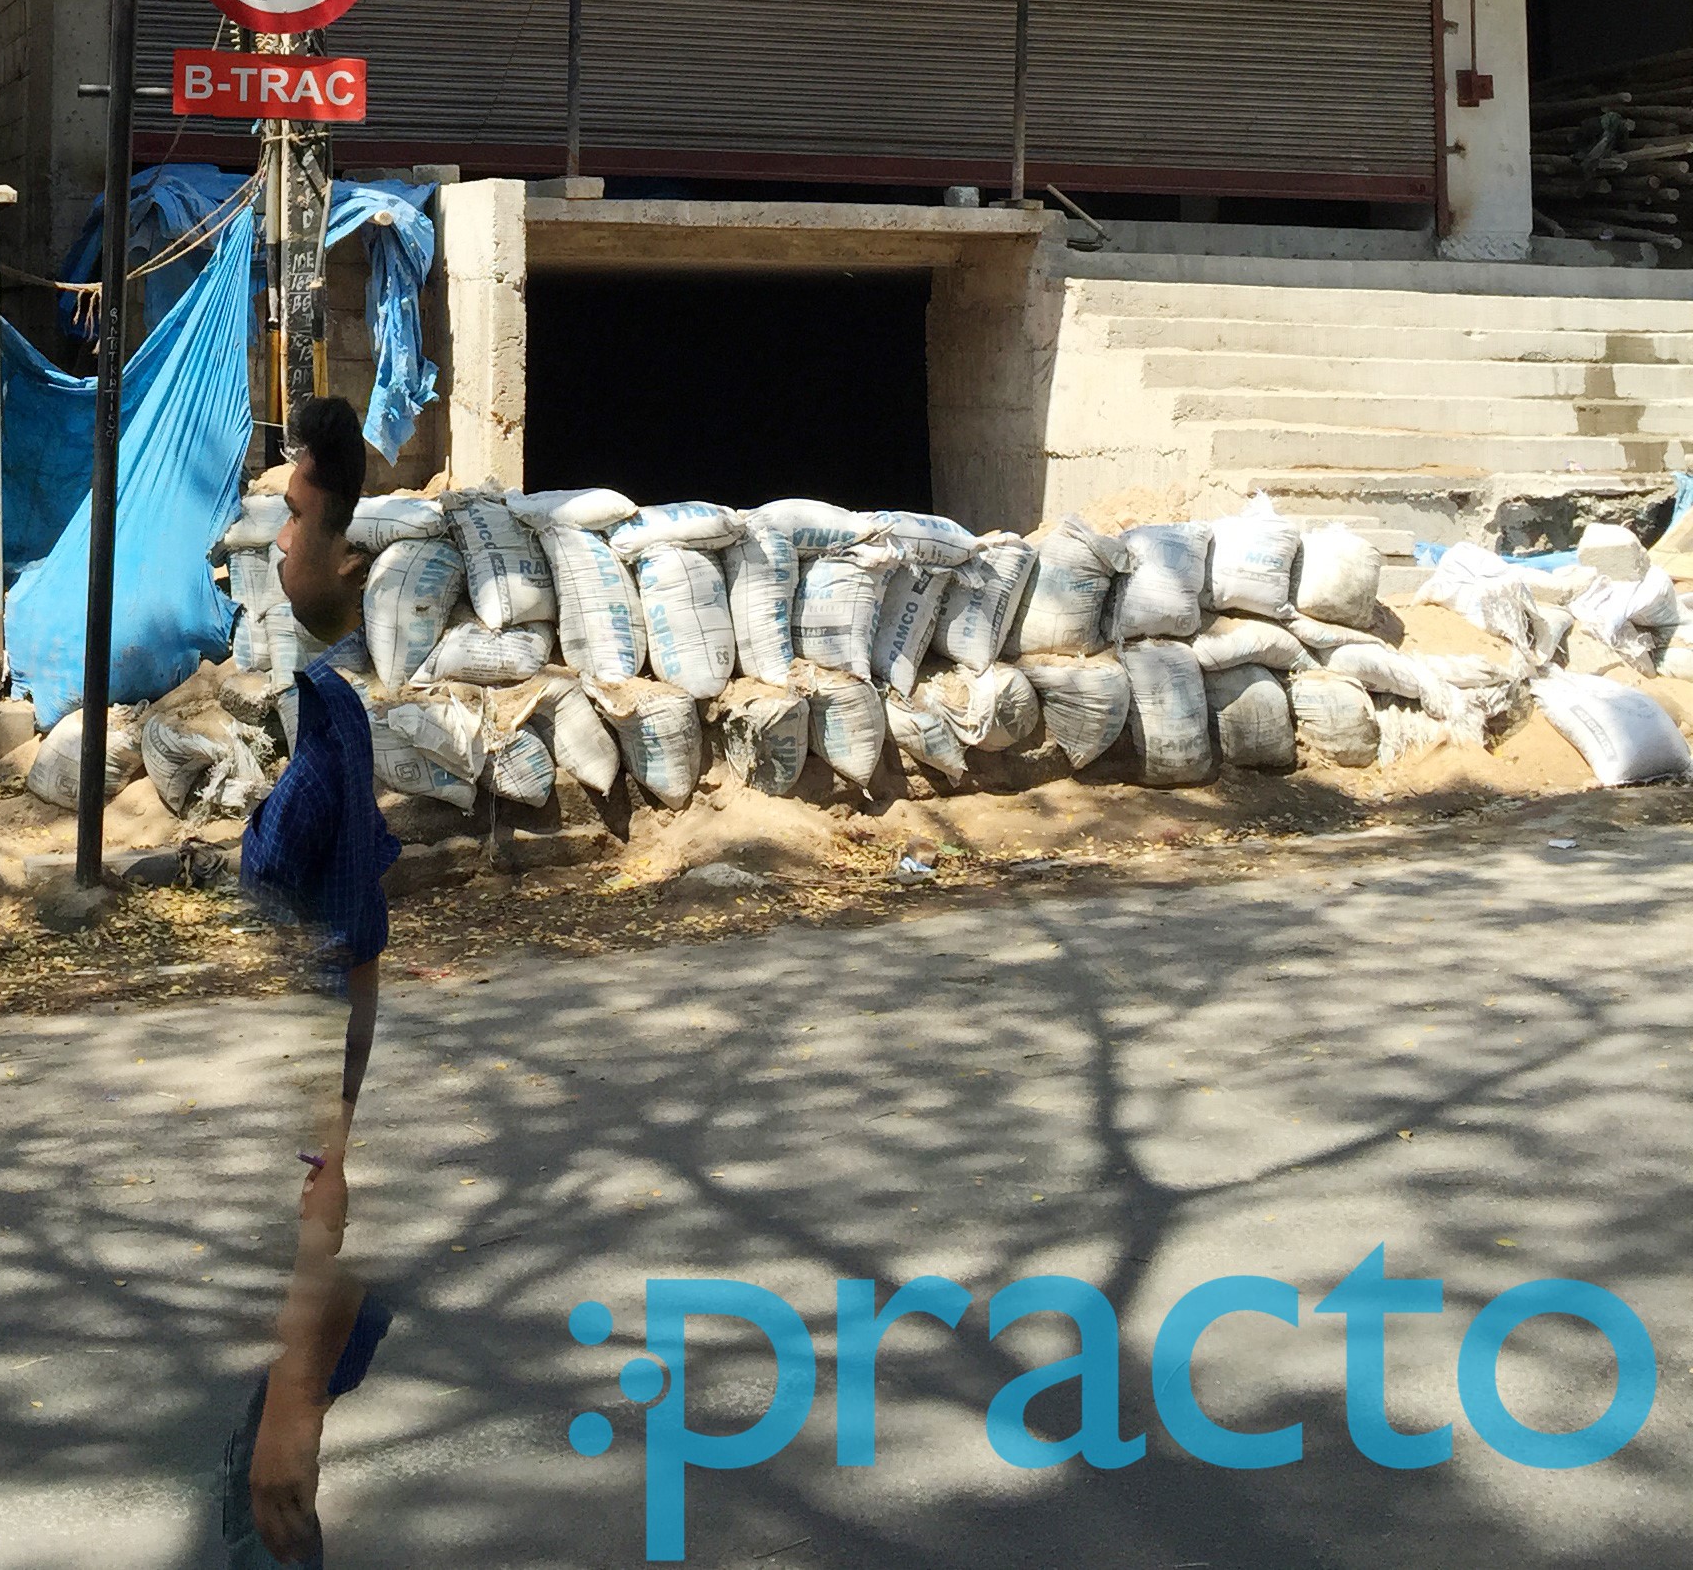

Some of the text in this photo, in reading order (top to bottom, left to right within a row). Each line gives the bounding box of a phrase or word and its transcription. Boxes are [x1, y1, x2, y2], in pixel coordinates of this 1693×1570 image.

[184, 64, 356, 106] B-TRAC
[647, 603, 682, 680] SUPER
[889, 601, 919, 662] RAMCO
